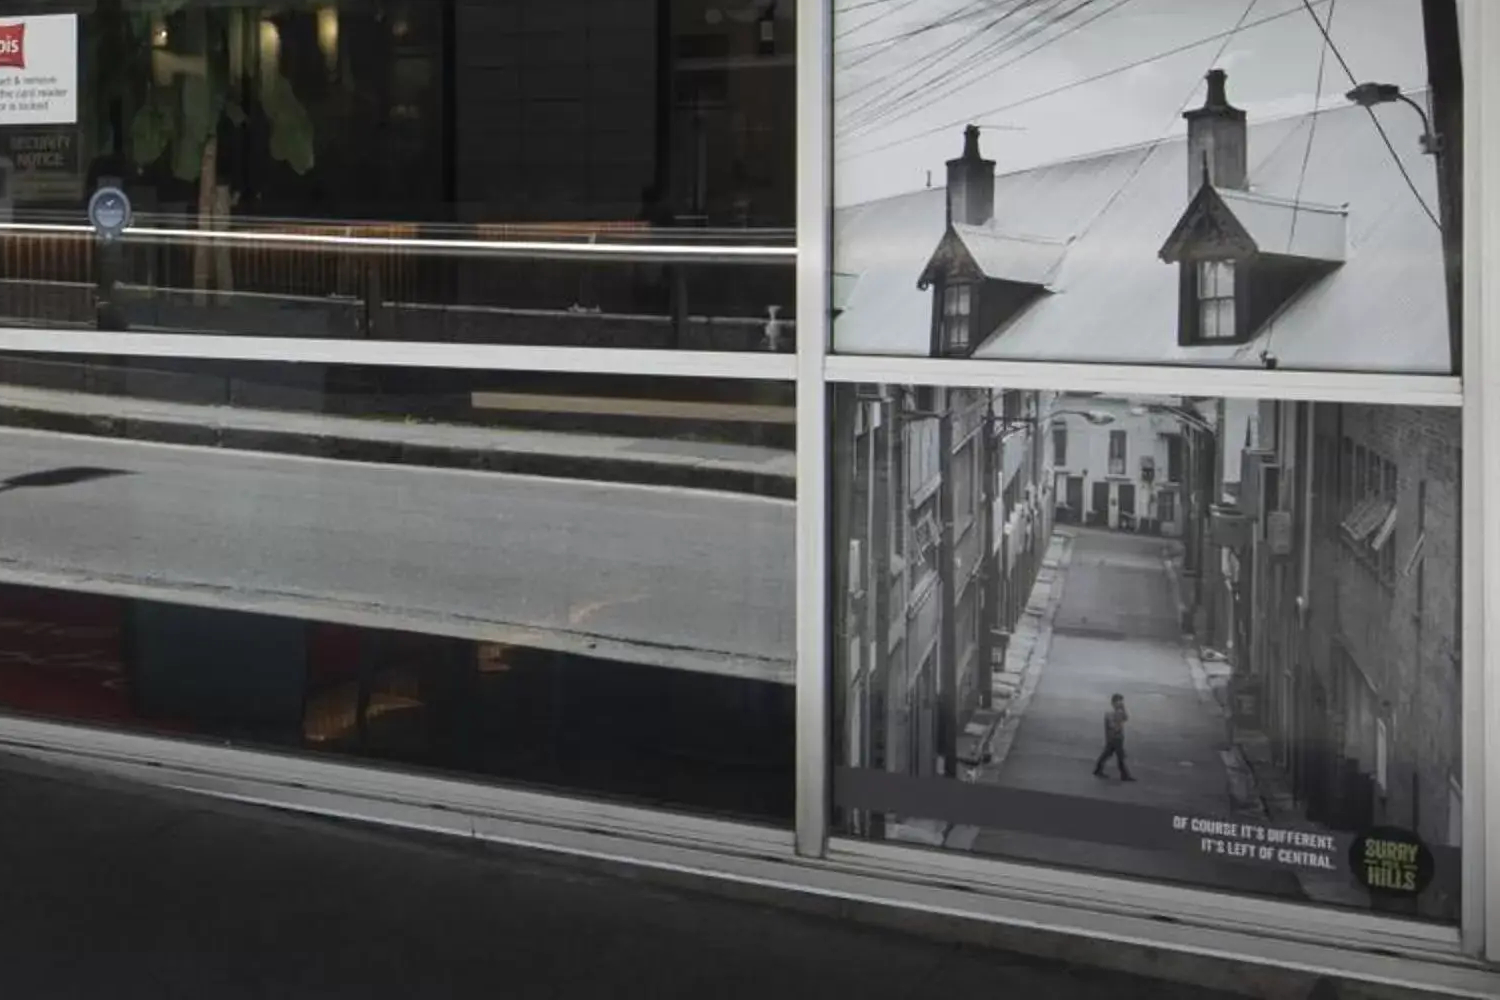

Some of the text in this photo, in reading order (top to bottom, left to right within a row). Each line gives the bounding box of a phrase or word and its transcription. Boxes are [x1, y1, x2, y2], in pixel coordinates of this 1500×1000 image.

[1172, 815, 1337, 851] OF COURSE IT'S DIFFERENT.
[1201, 838, 1337, 869] IT'S LEFT OF CENTRAL.
[1364, 838, 1418, 863] SURRY
[1367, 865, 1416, 890] HILLS
